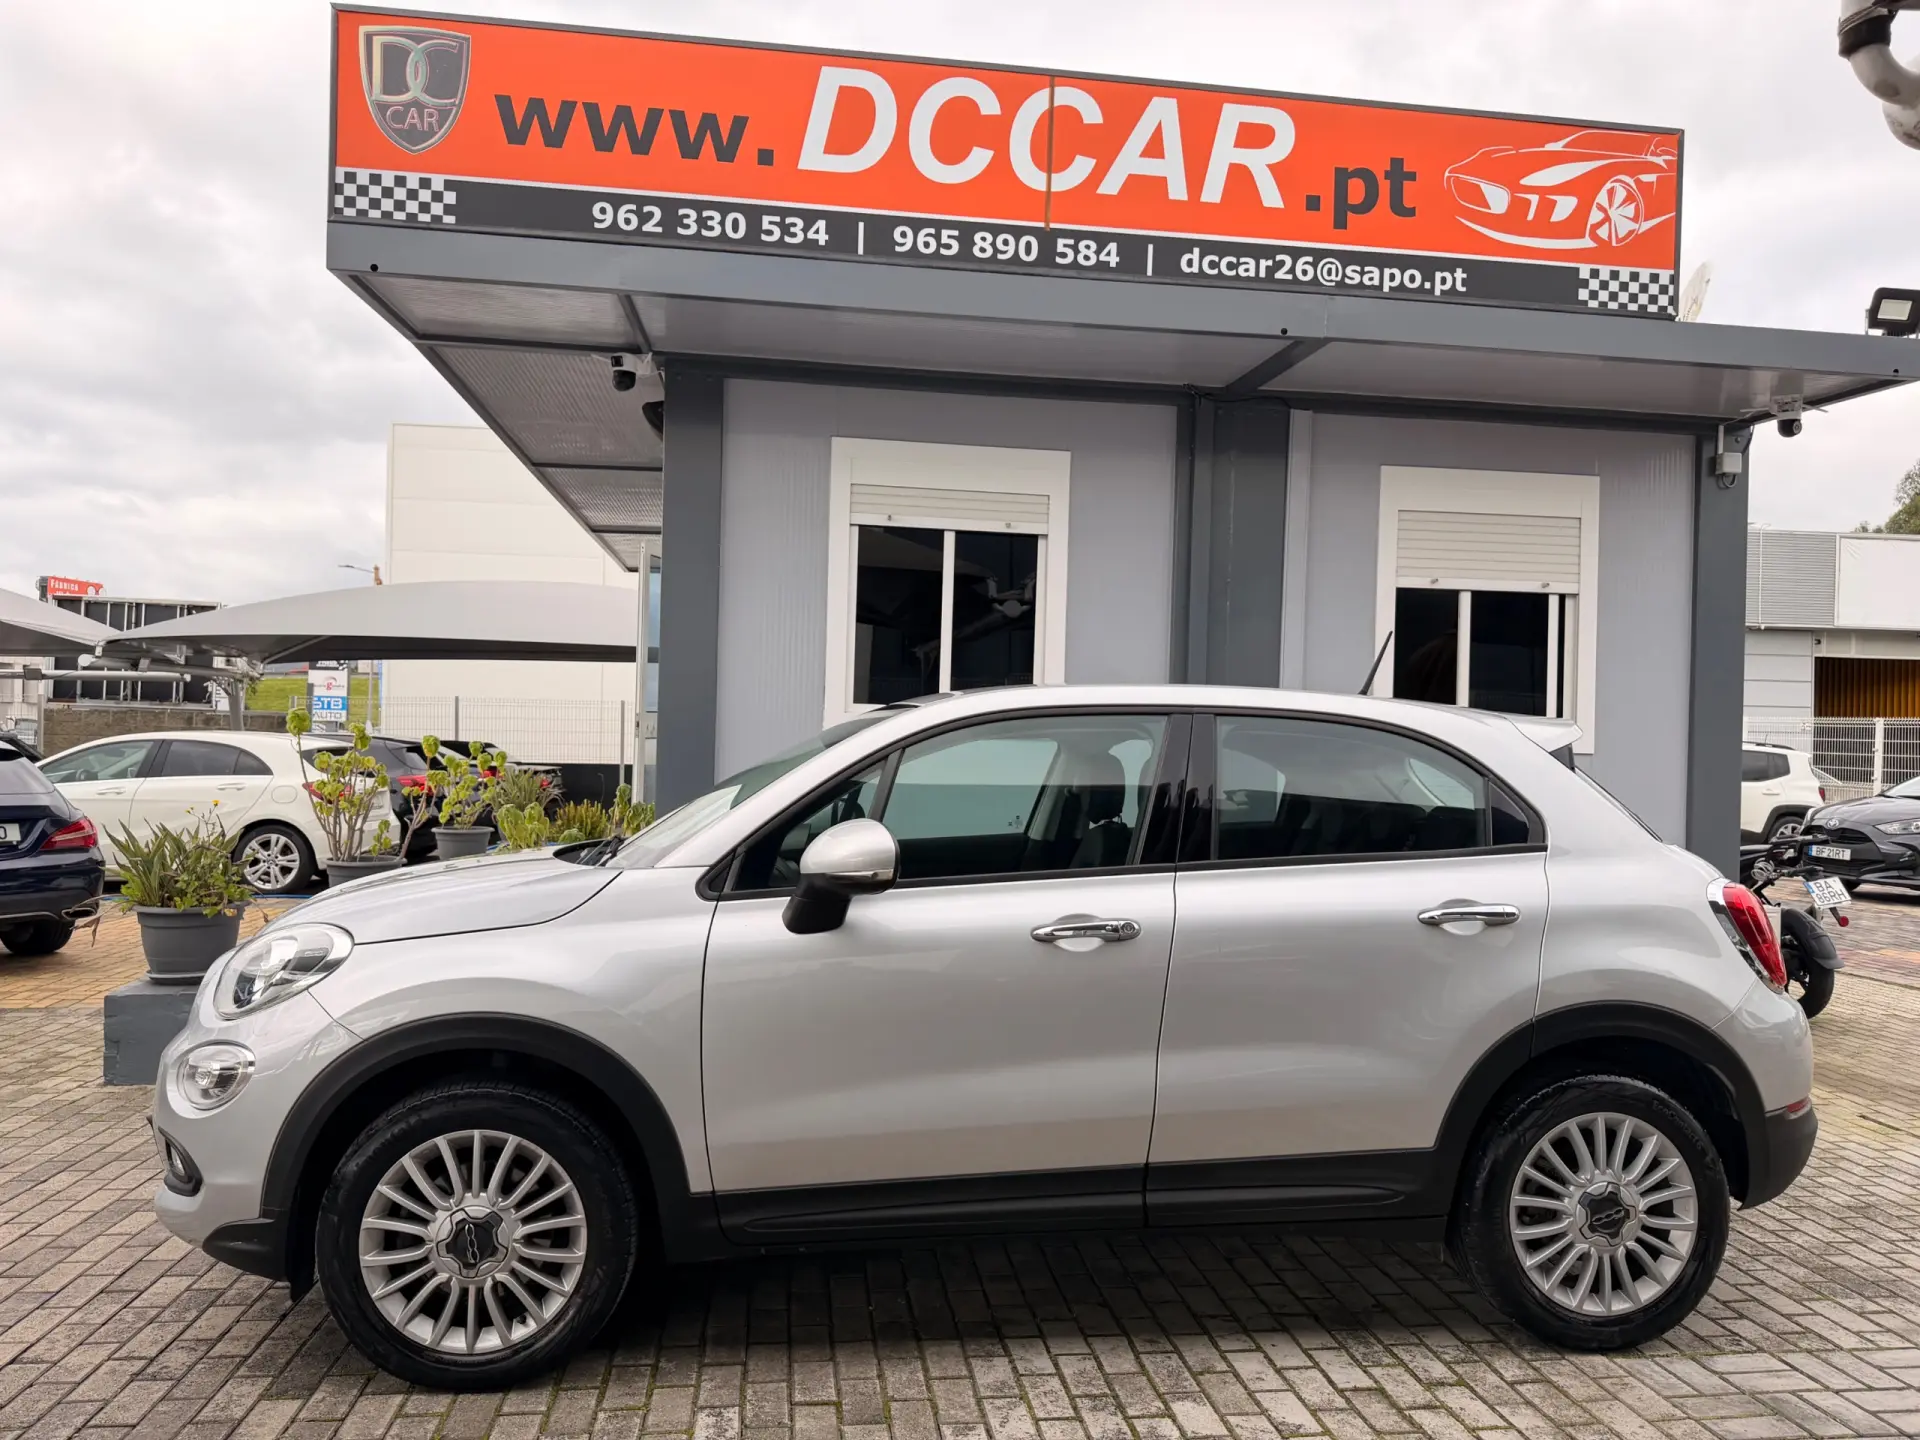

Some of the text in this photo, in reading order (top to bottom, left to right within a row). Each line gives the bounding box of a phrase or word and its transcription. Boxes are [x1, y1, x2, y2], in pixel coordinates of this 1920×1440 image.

[372, 35, 459, 106] DC
[386, 105, 440, 132] CAR
[797, 65, 1296, 209] DCCAR
[591, 201, 663, 233] 962
[676, 208, 746, 239] 330
[760, 216, 829, 246] 534
[893, 225, 960, 256] 965
[972, 231, 1039, 262] 890
[1055, 238, 1120, 268] 584
[1180, 247, 1467, 296] dccar26@sapo.pt
[313, 697, 343, 709] STB
[313, 711, 342, 720] AUTO
[1814, 880, 1835, 892] BA
